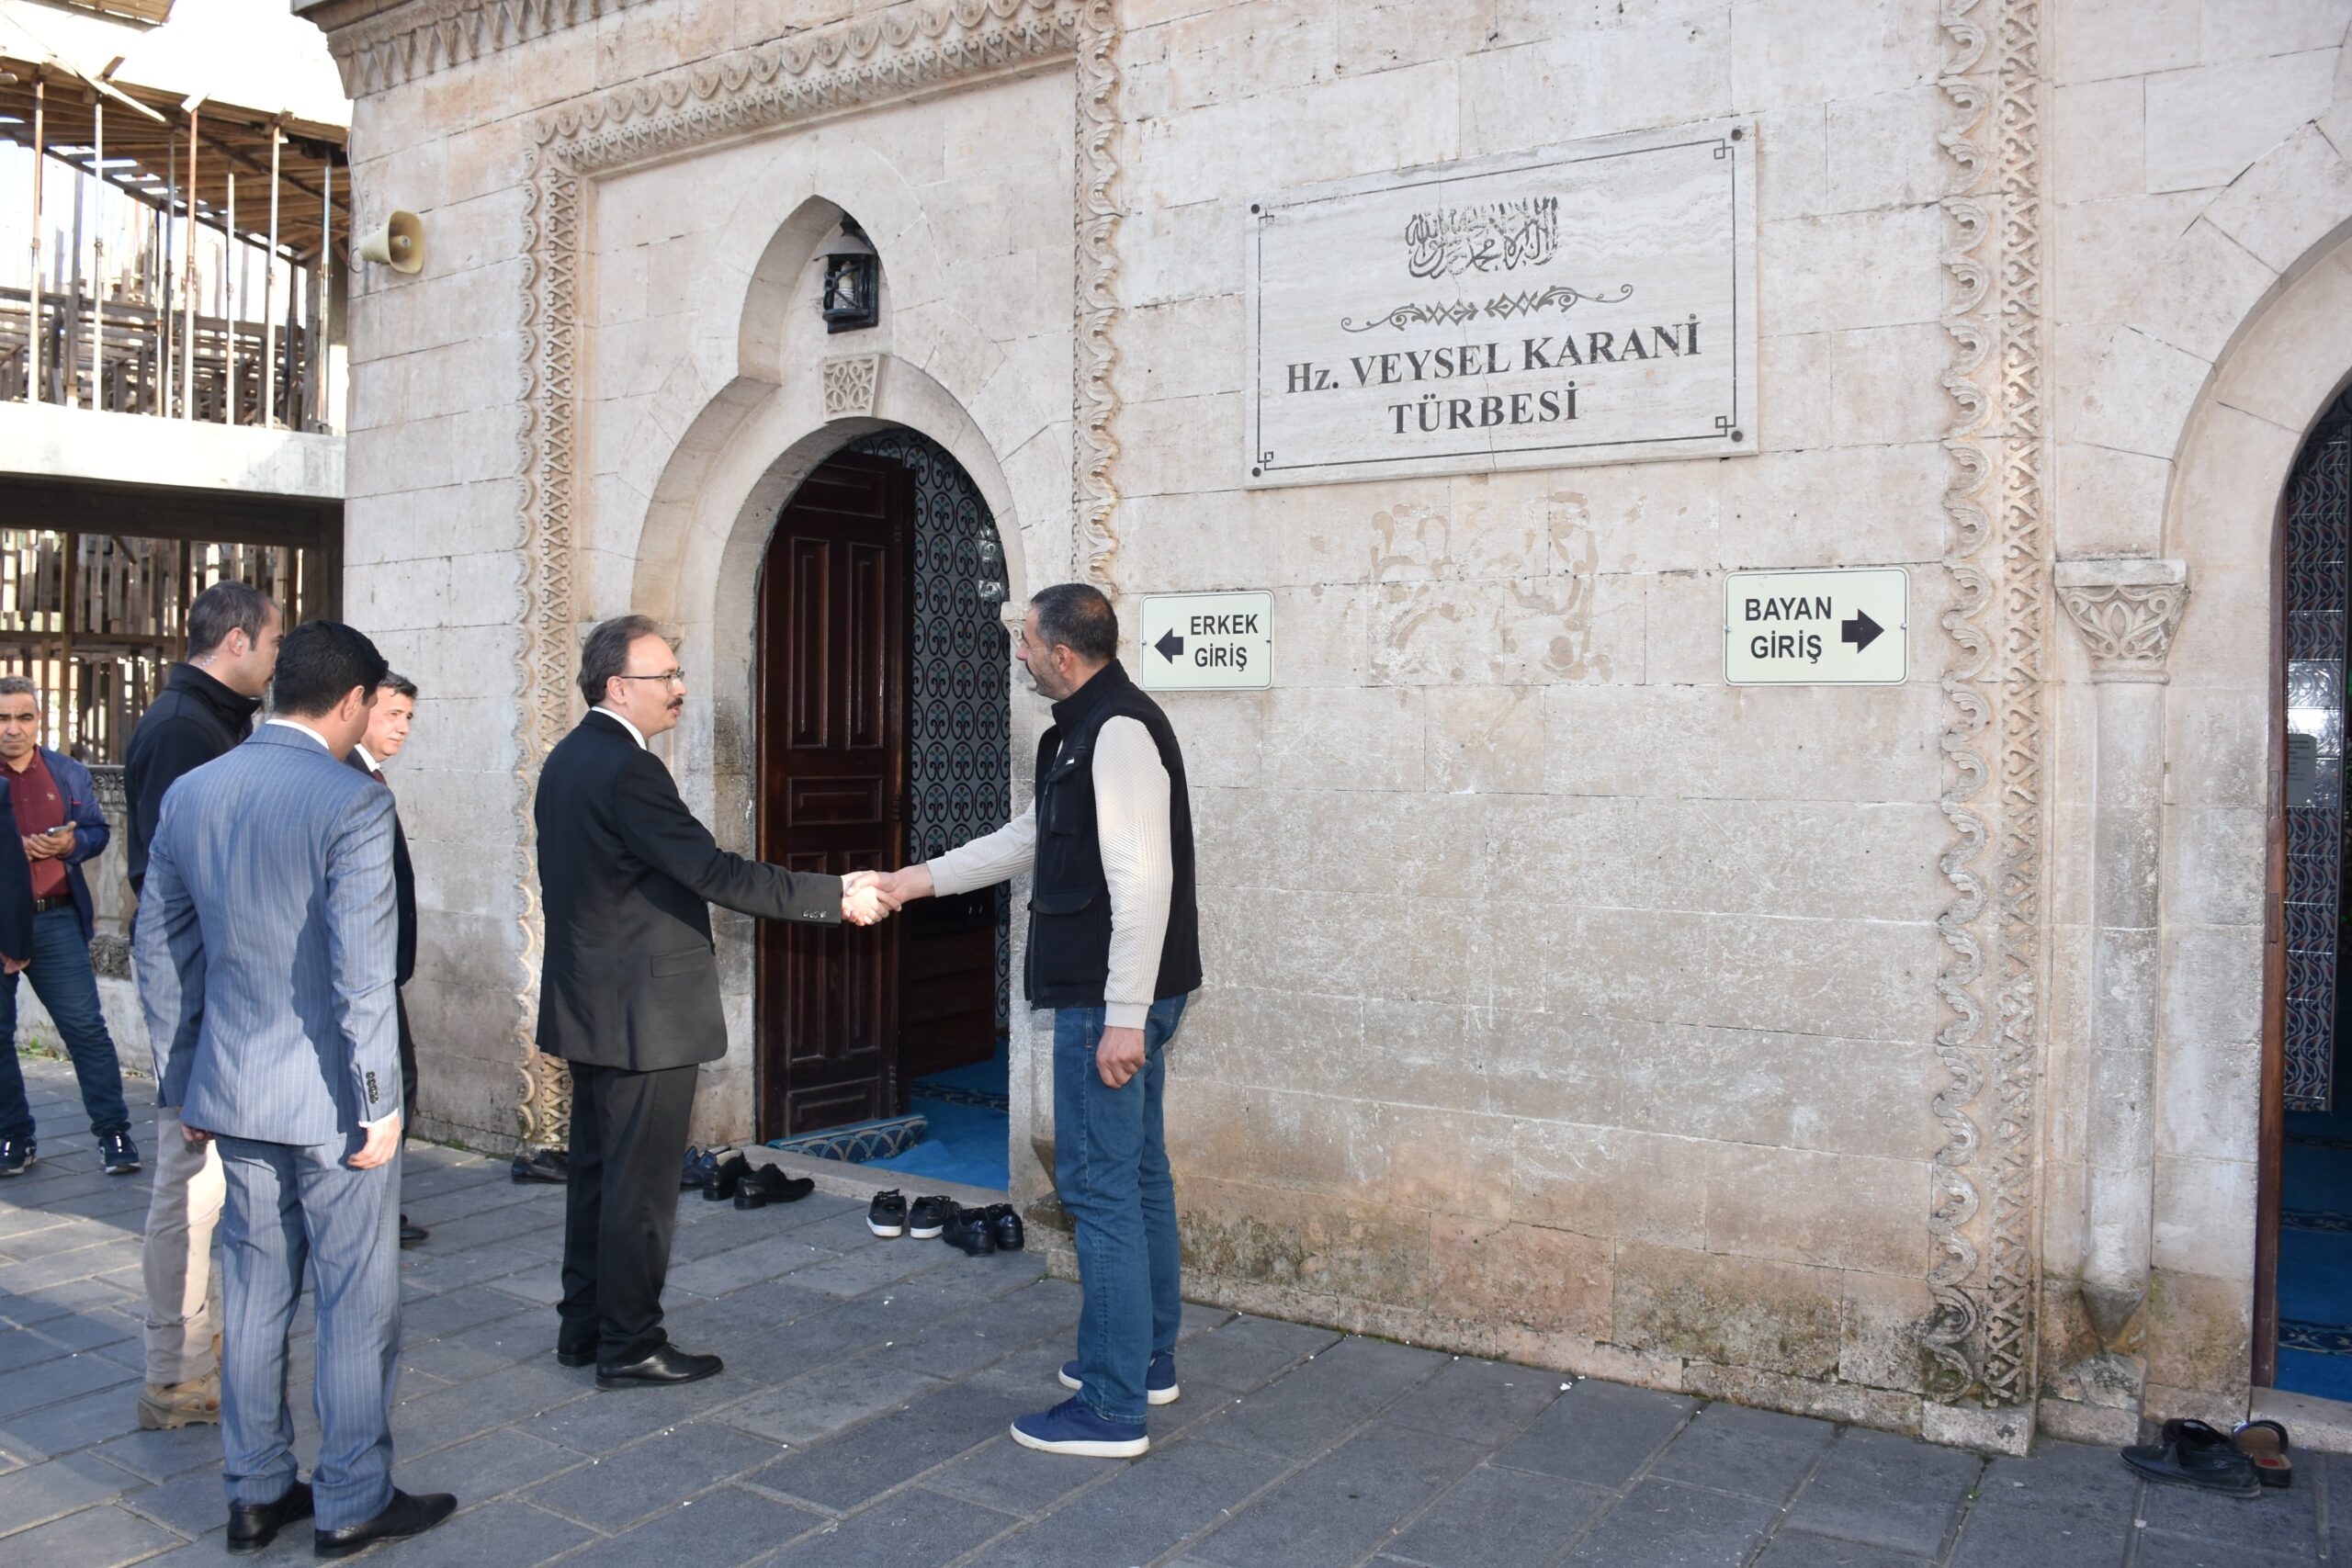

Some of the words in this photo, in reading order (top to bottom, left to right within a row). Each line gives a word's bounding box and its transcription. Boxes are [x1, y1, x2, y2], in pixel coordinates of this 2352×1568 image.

[1286, 363, 1339, 394] Hz.
[1349, 342, 1510, 388] VEYSEL
[1521, 313, 1701, 371] KARANİ
[1388, 380, 1579, 434] TÜRBESİ
[1191, 614, 1259, 636] ERKEK
[1745, 596, 1832, 622] BAYAN
[1195, 642, 1248, 671] GİRİŞ
[1750, 629, 1822, 664] GİRİŞ
